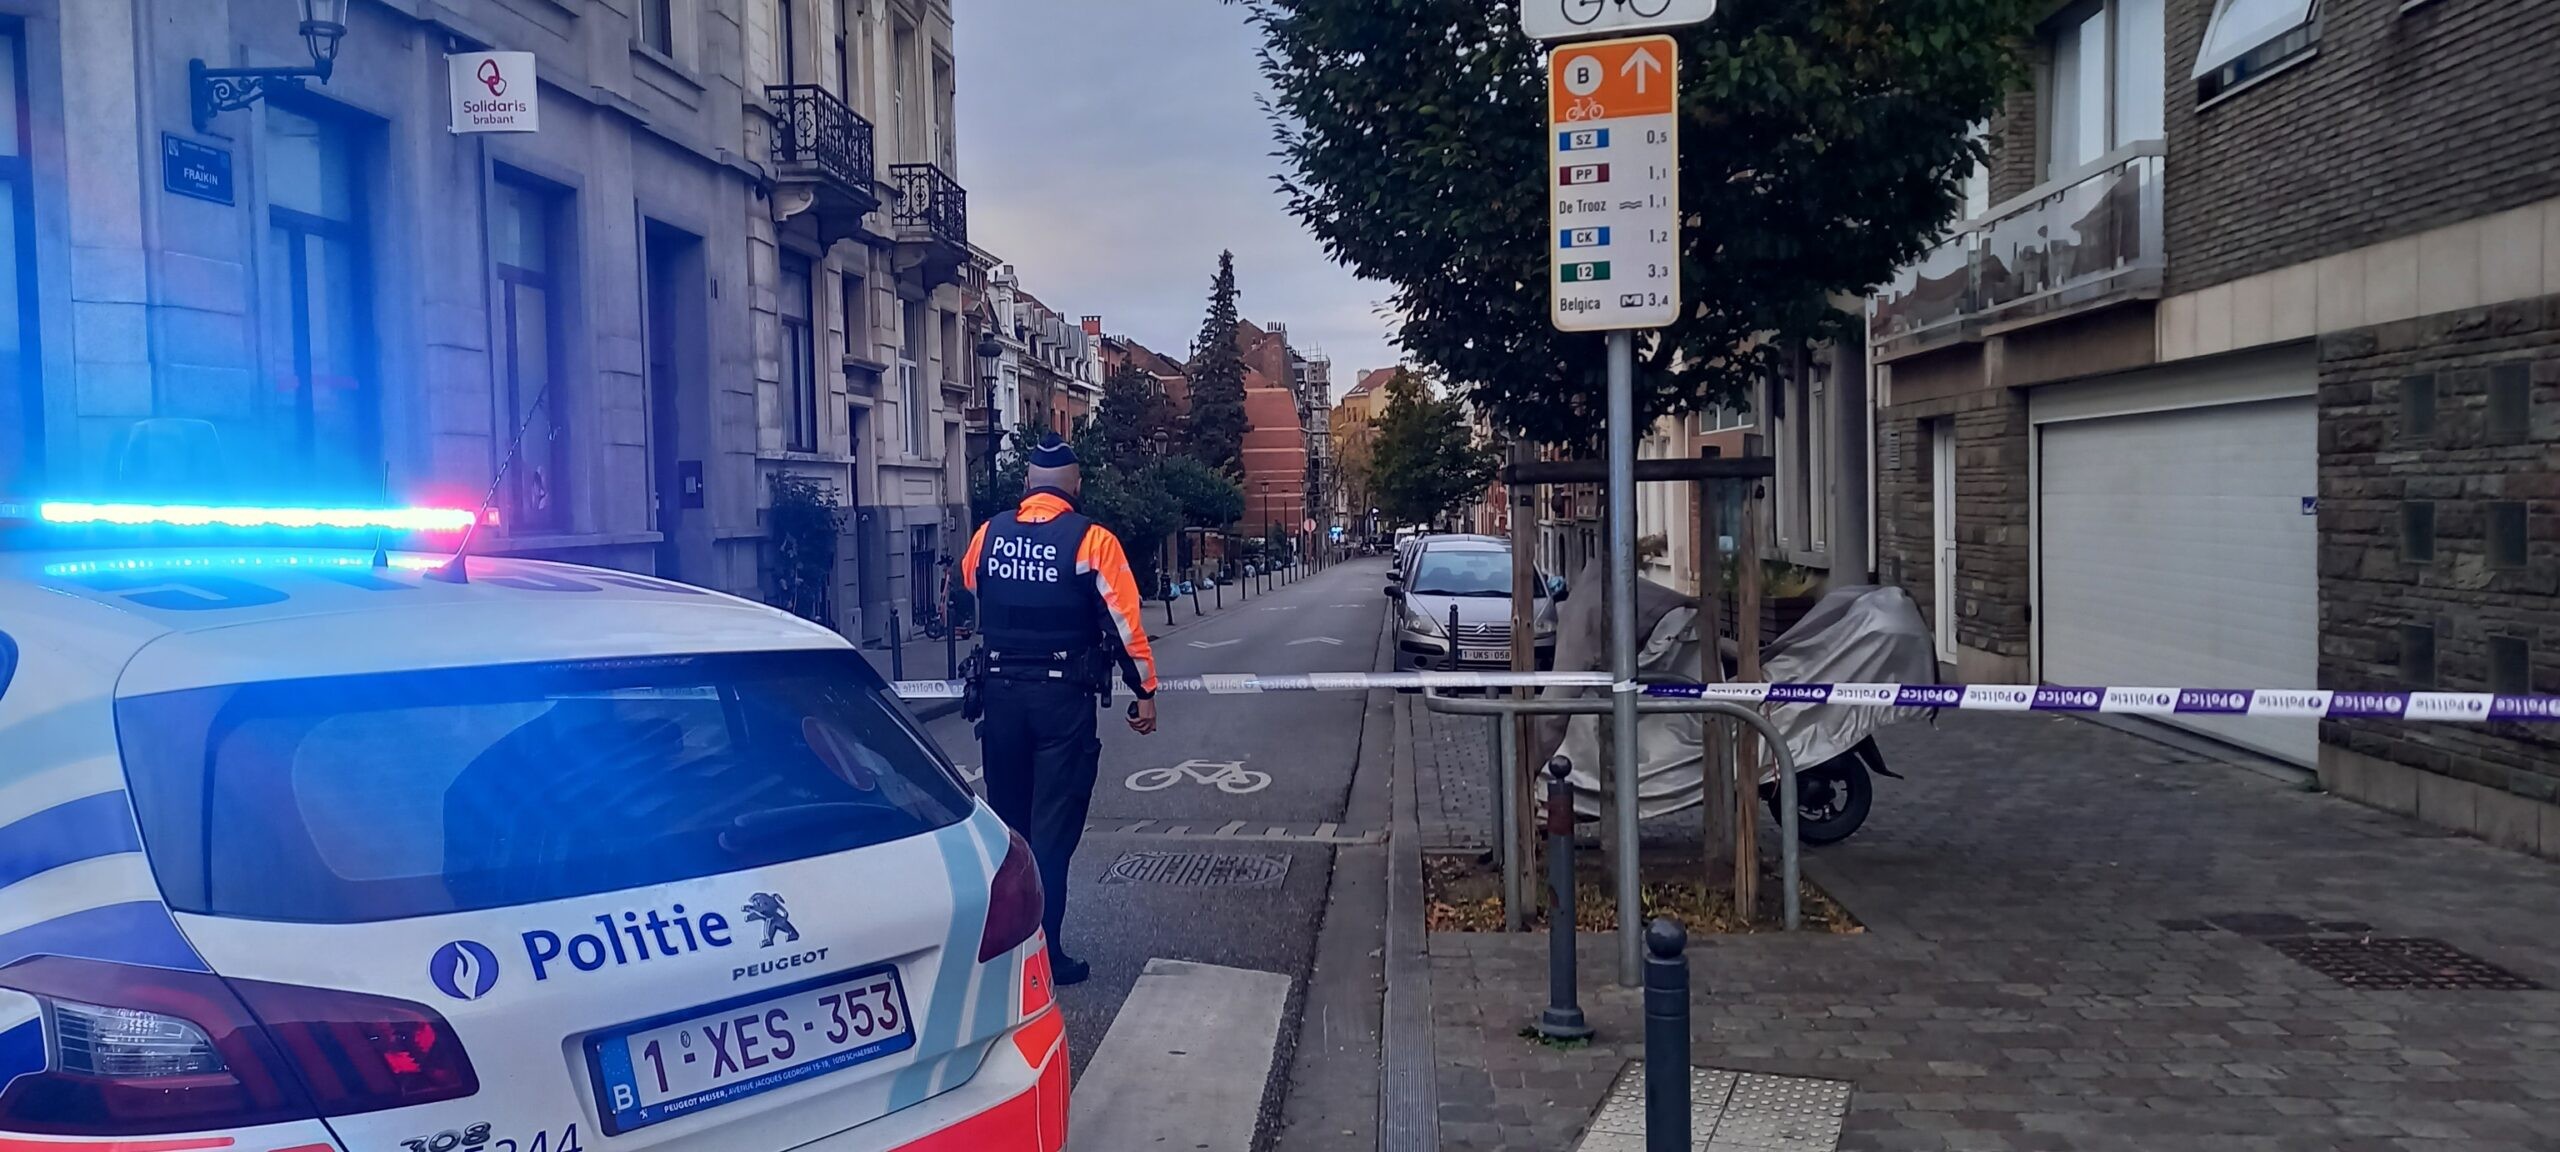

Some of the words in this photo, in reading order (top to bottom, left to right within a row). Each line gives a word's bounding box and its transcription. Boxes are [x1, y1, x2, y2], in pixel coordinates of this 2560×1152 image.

[1577, 67, 1590, 84] B
[463, 99, 527, 114] Solidaris
[473, 113, 514, 125] brabant
[1576, 134, 1592, 145] SZ
[184, 167, 218, 186] FRAIKIN
[1576, 169, 1592, 180] PP
[1560, 201, 1573, 214] De
[1577, 200, 1606, 212] Trooz
[1577, 232, 1593, 243] CK
[1579, 267, 1592, 277] 12
[1560, 298, 1601, 313] Belgica
[992, 537, 1056, 560] Police
[988, 558, 1058, 582] Politie
[1772, 688, 1811, 697] Police
[1837, 689, 1876, 698] Politie
[1901, 689, 1942, 700] Police
[1970, 691, 2011, 701] Politie
[2038, 691, 2082, 705] Police
[2110, 693, 2155, 704] Politie
[2182, 692, 2230, 708] Police
[2258, 695, 2305, 708] Politie
[2335, 695, 2383, 711] Police
[2496, 698, 2547, 715] Police
[521, 903, 733, 981] Politie
[732, 947, 829, 981] PEUGEOT
[643, 982, 899, 1093] 1-XES-353
[664, 1097, 698, 1113] PEUGEOT
[699, 1088, 728, 1104] MEISER,
[729, 1081, 754, 1095] AVENUE
[755, 1074, 782, 1088] JACQUES
[783, 1065, 811, 1080] GEORGIN
[612, 1084, 634, 1111] B
